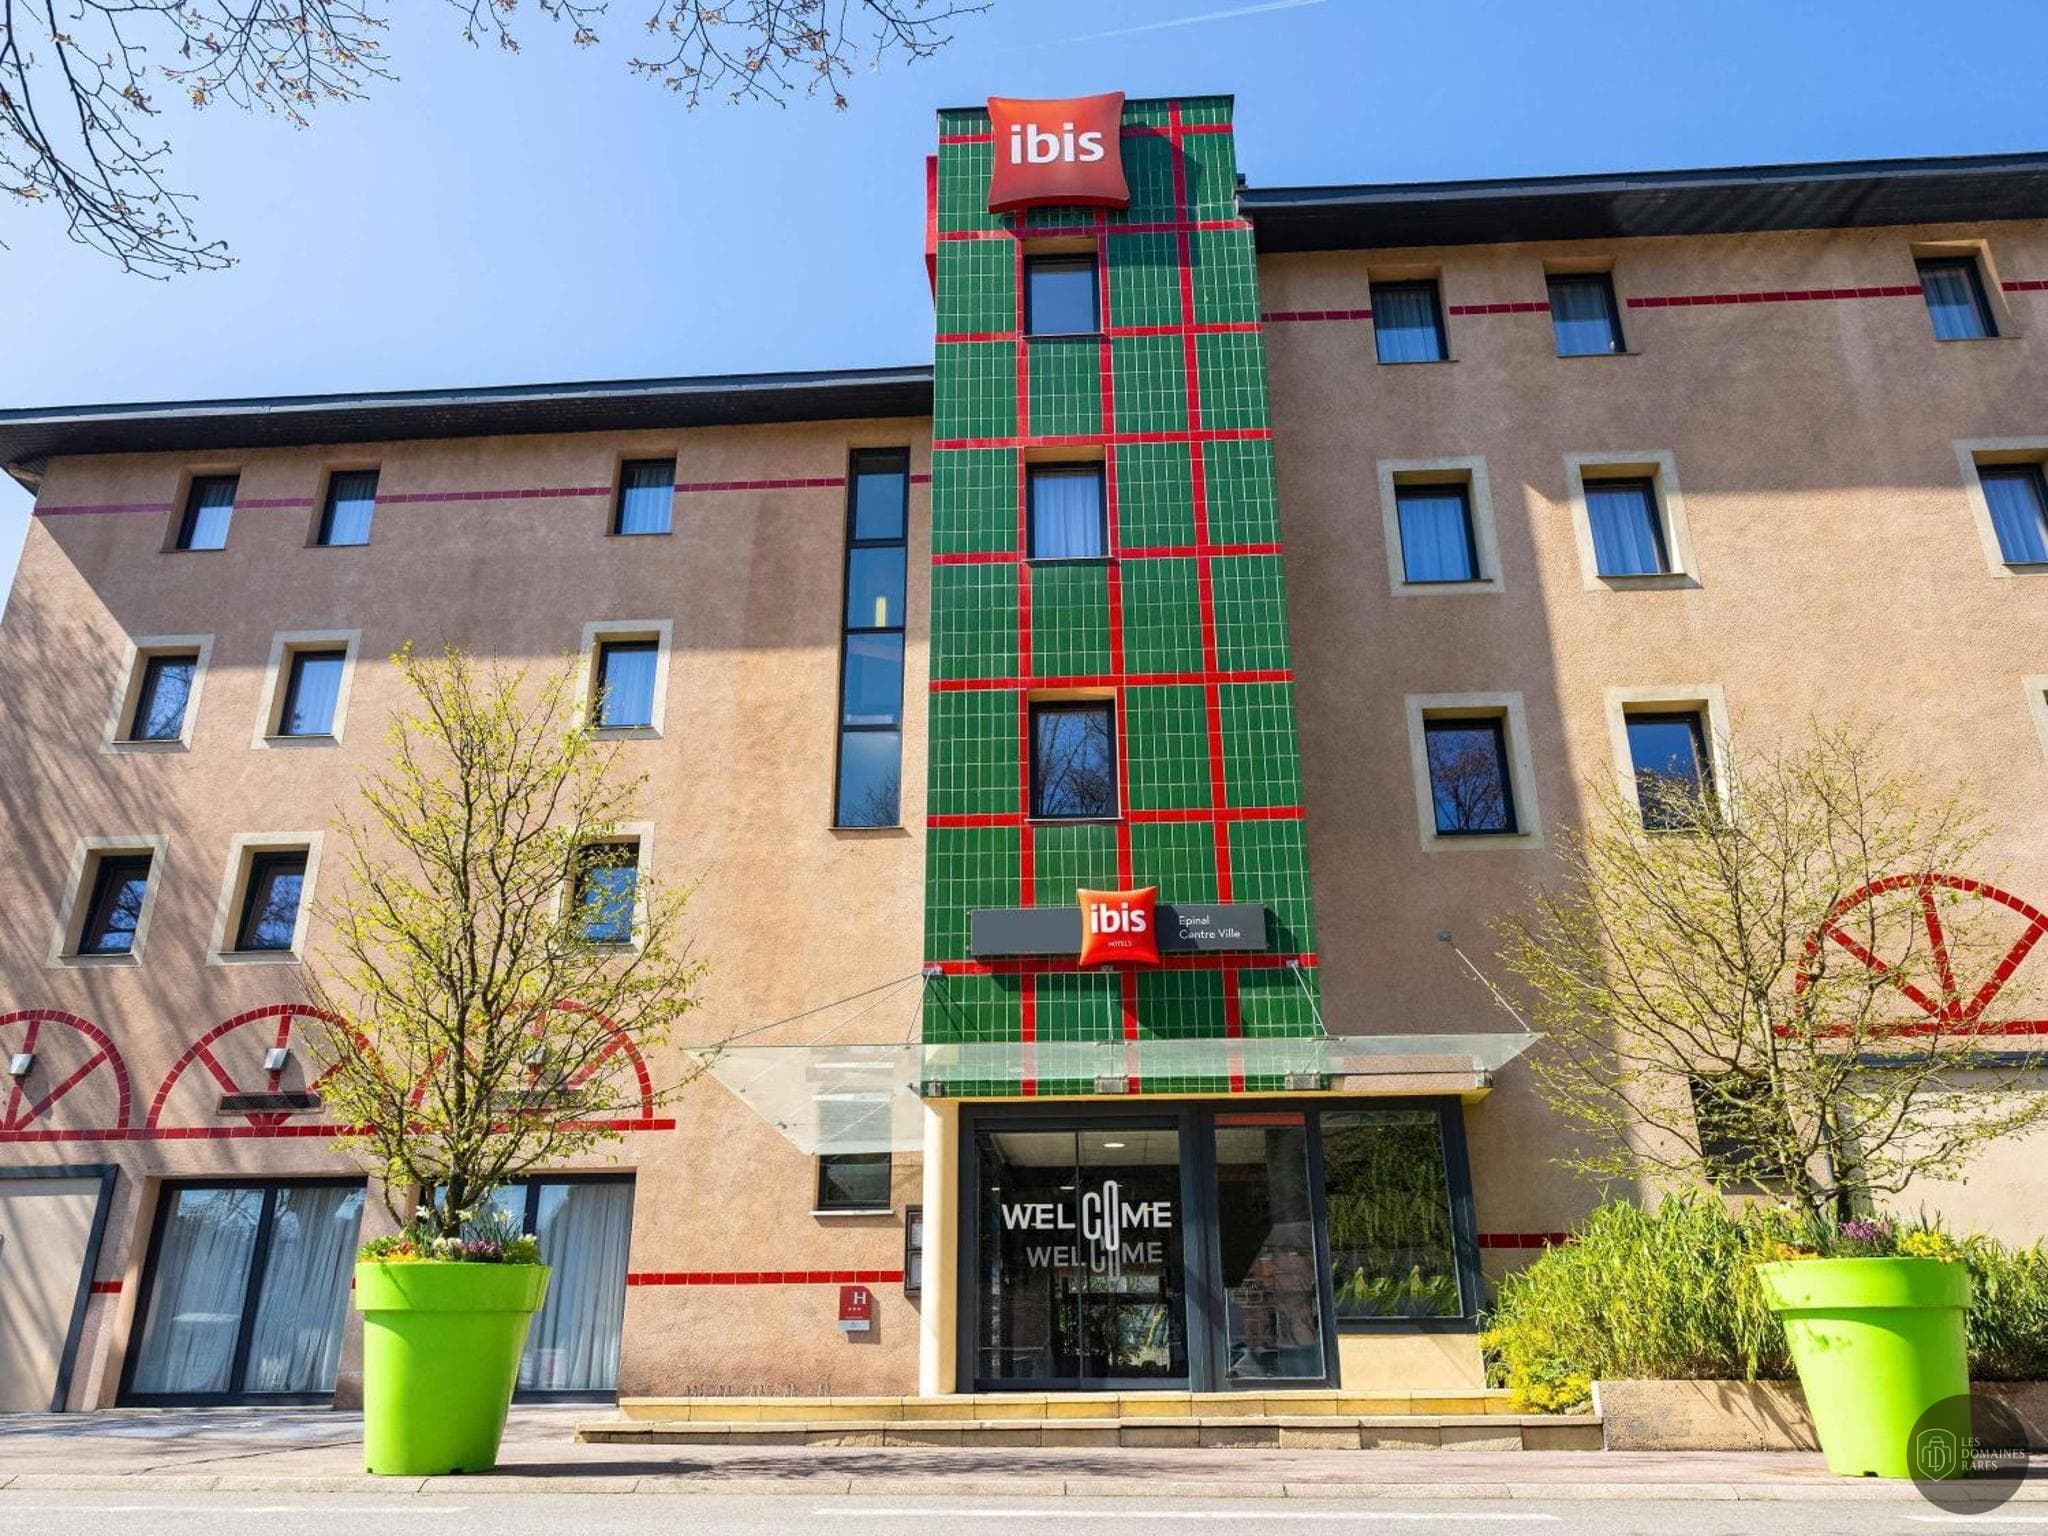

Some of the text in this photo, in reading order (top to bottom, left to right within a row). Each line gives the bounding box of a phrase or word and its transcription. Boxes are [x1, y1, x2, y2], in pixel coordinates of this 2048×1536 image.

[1011, 122, 1104, 164] ibis
[1090, 902, 1147, 934] ibis
[1179, 915, 1210, 927] Epinal
[1179, 928, 1241, 939] Centre Ville
[1108, 940, 1133, 948] HOTELS
[1001, 1180, 1173, 1251] WELCOME
[853, 1291, 867, 1305] H
